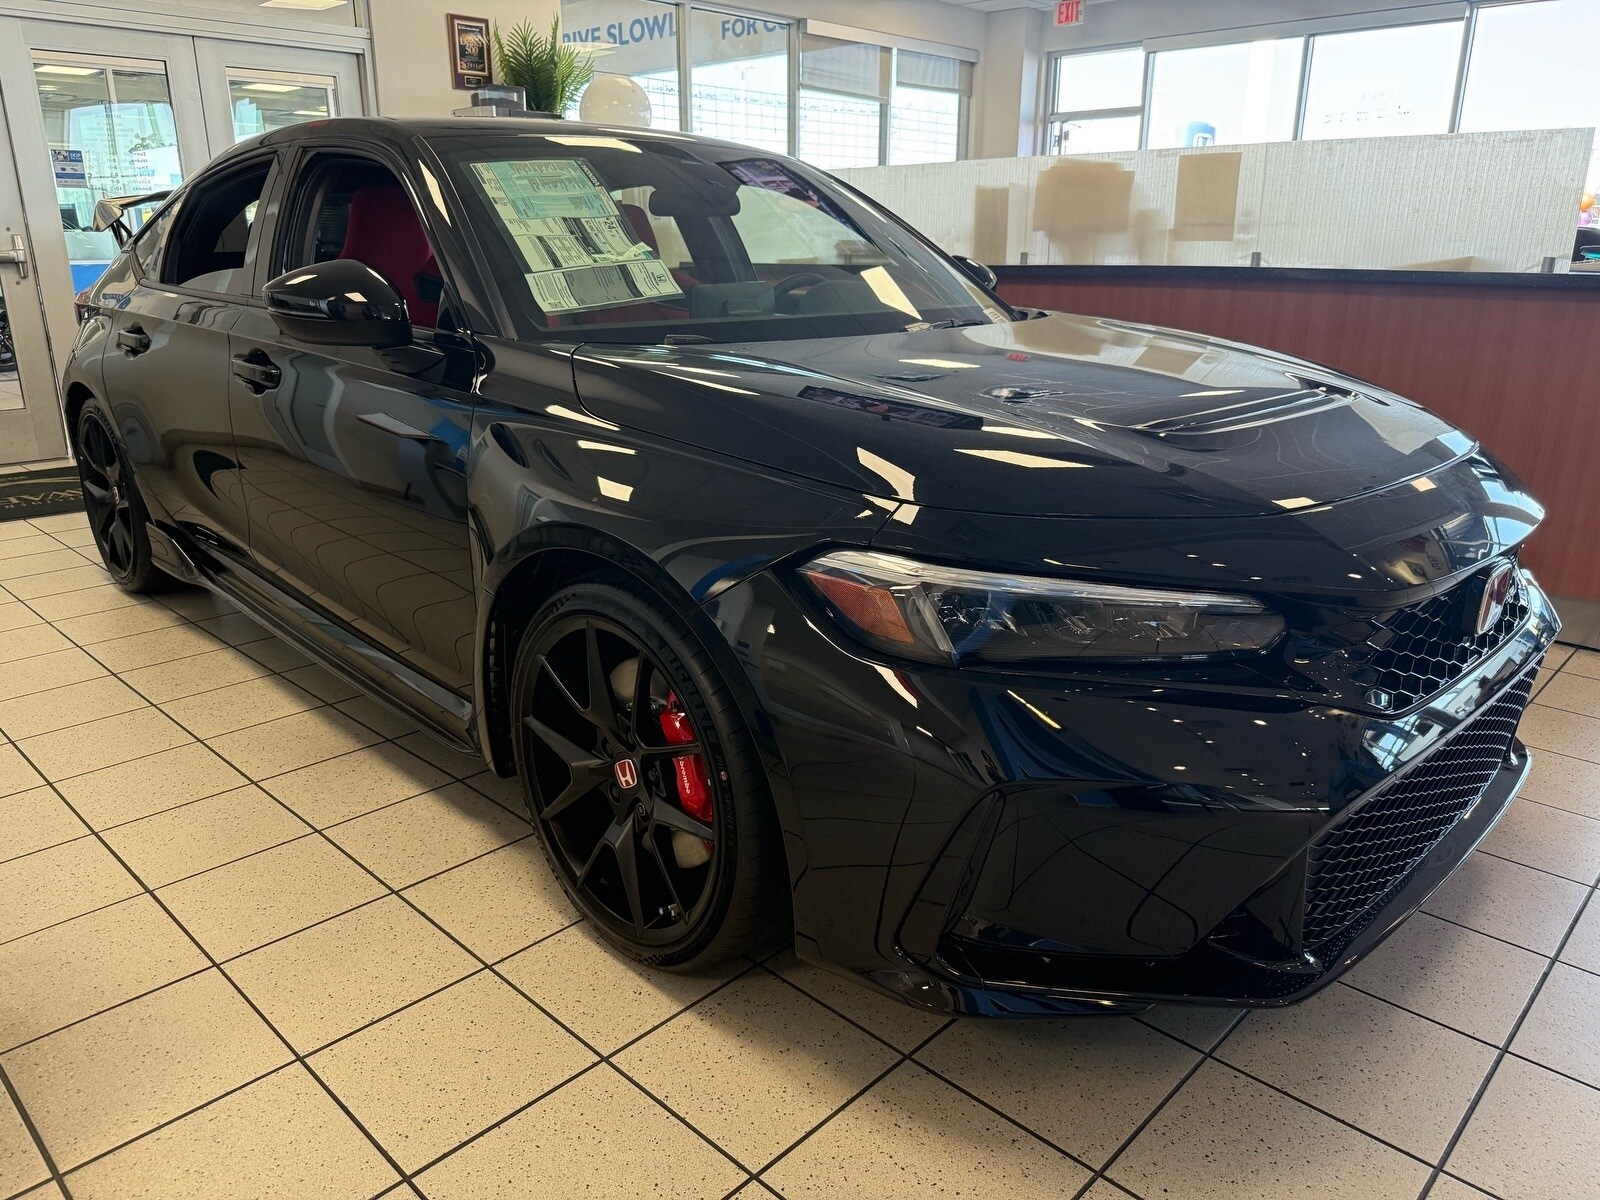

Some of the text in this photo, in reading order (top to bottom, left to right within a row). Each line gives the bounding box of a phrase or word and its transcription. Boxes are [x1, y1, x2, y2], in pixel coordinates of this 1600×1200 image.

[1057, 1, 1080, 24] EXIT
[721, 18, 758, 40] FOR
[679, 760, 691, 795] brembo
